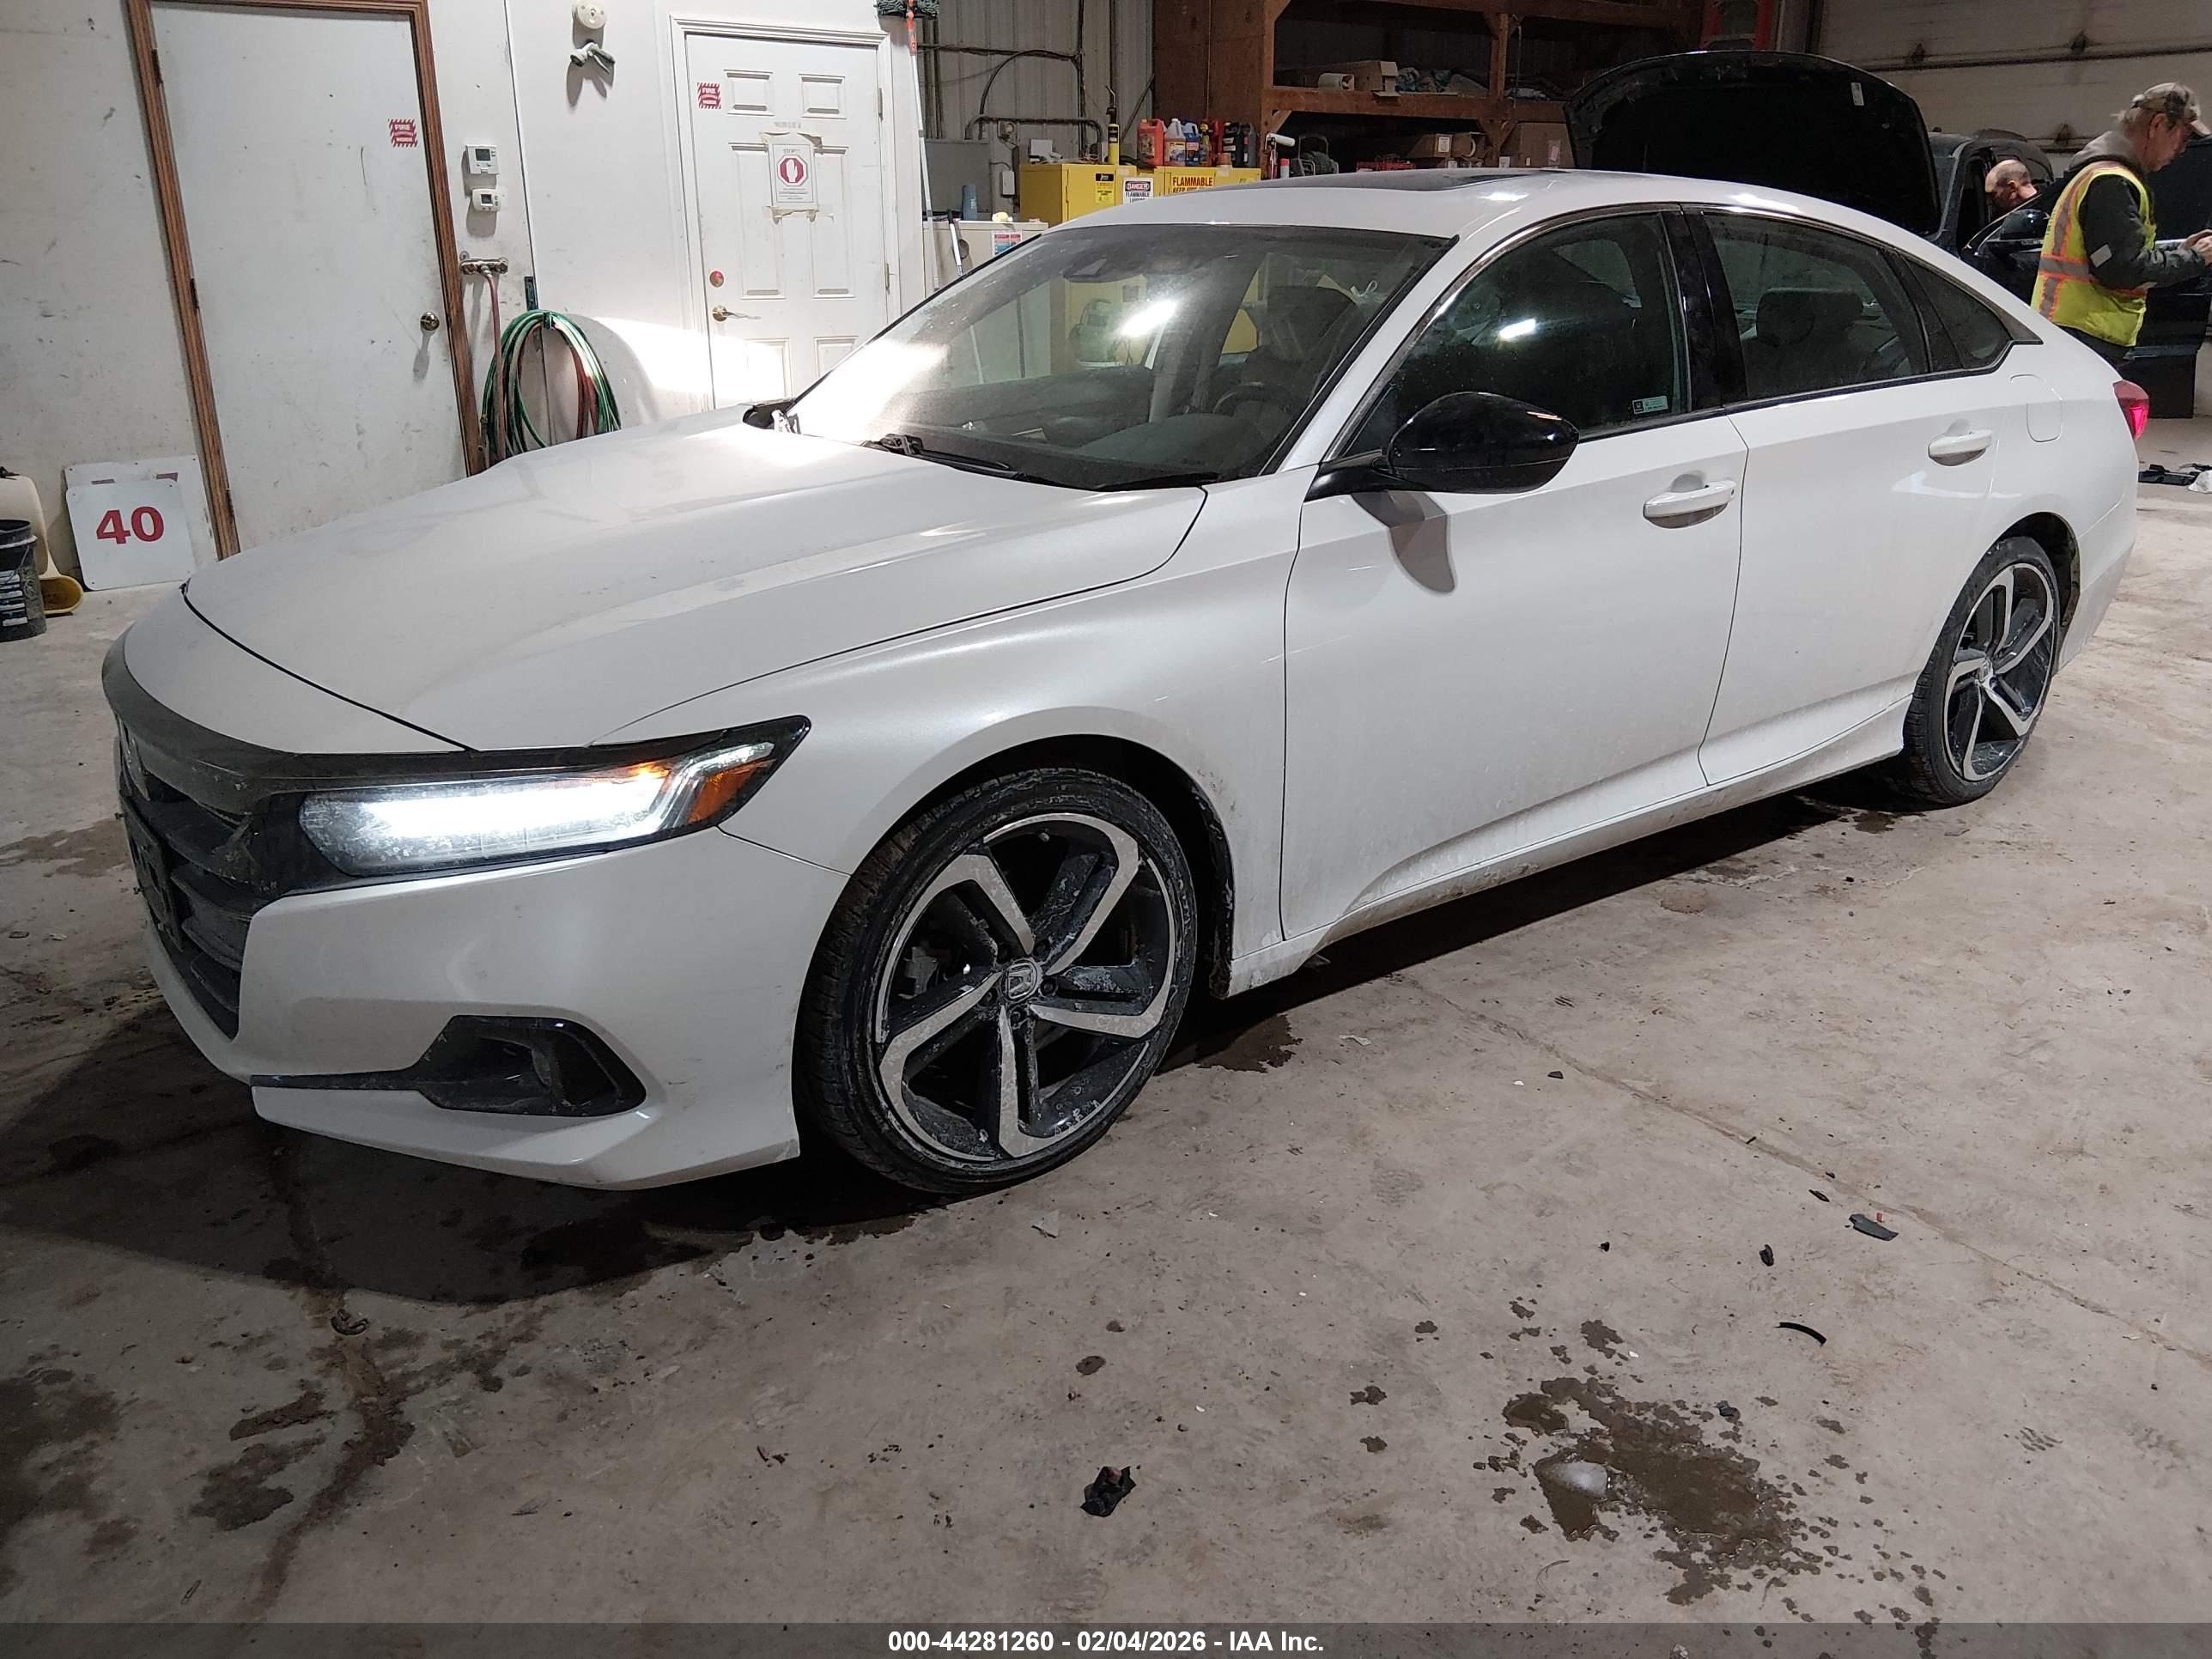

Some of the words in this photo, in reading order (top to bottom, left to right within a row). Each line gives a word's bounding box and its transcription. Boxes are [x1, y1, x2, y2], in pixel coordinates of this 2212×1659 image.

[1127, 182, 1150, 191] DANGER
[1173, 177, 1212, 187] FLAMMABLE
[96, 505, 165, 544] 40
